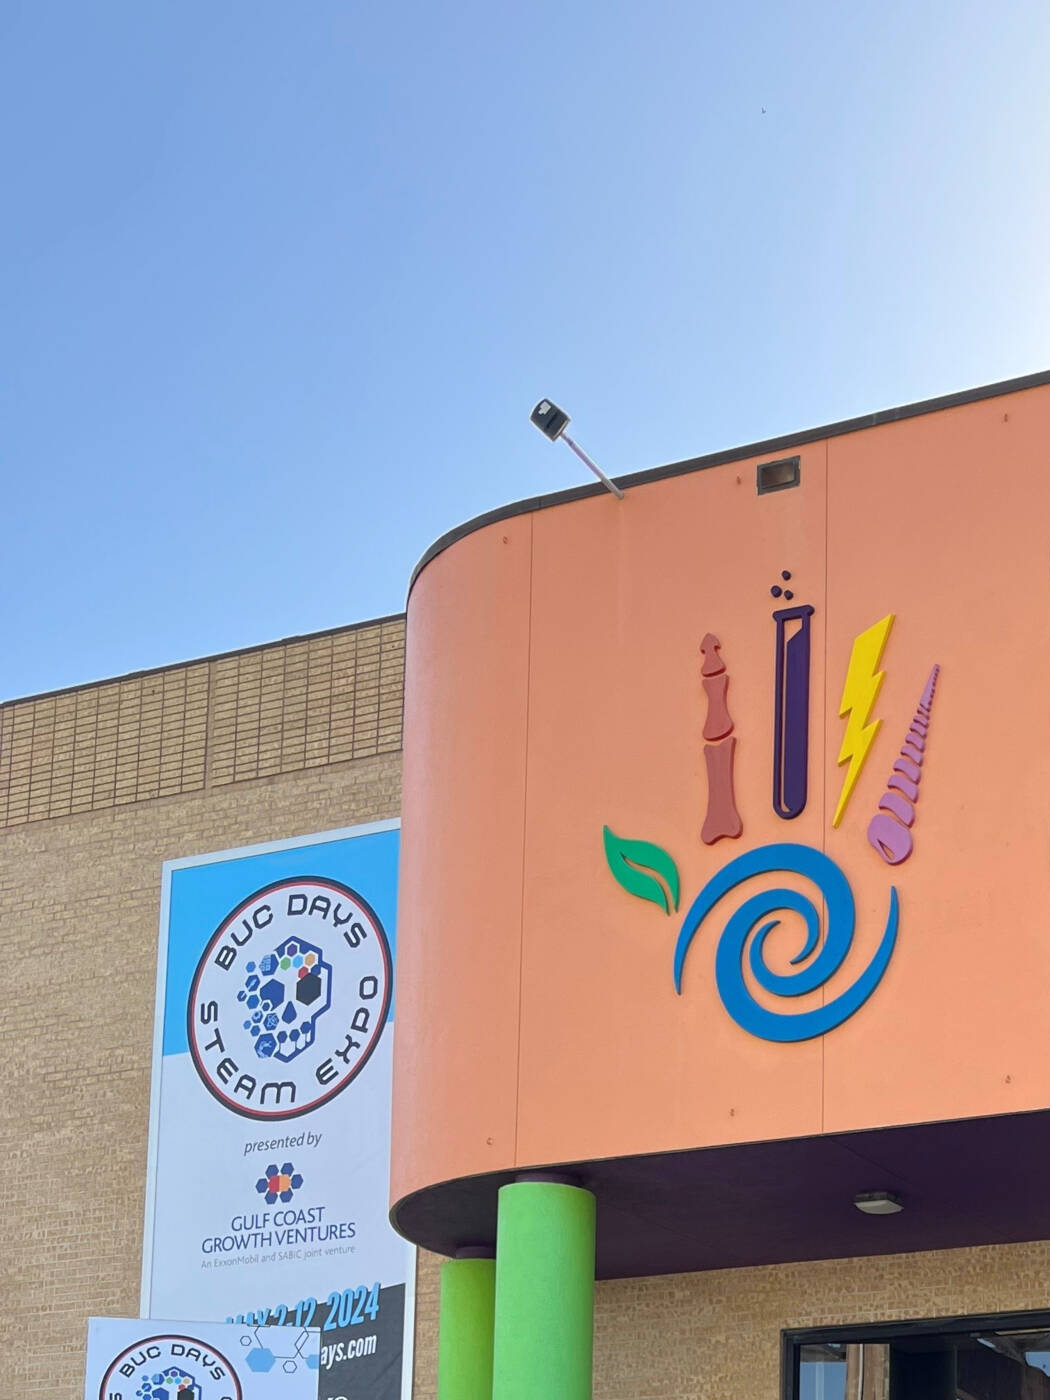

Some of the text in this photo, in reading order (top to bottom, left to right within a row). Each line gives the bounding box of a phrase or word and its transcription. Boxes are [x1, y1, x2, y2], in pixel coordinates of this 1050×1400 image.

[214, 894, 368, 972] BUC DAYS
[200, 975, 379, 1105] STEAM EXPO
[243, 1131, 322, 1156] presented by
[231, 1206, 326, 1232] GULF COAST
[201, 1222, 356, 1254] GROWTH VENTURES
[201, 1260, 212, 1269] An
[213, 1255, 259, 1268] ExxonMobil
[261, 1252, 276, 1262] and
[303, 1247, 322, 1261] joint
[324, 1245, 356, 1256] venture
[323, 1281, 381, 1332] 2024
[119, 1344, 226, 1381] BUC DAYS
